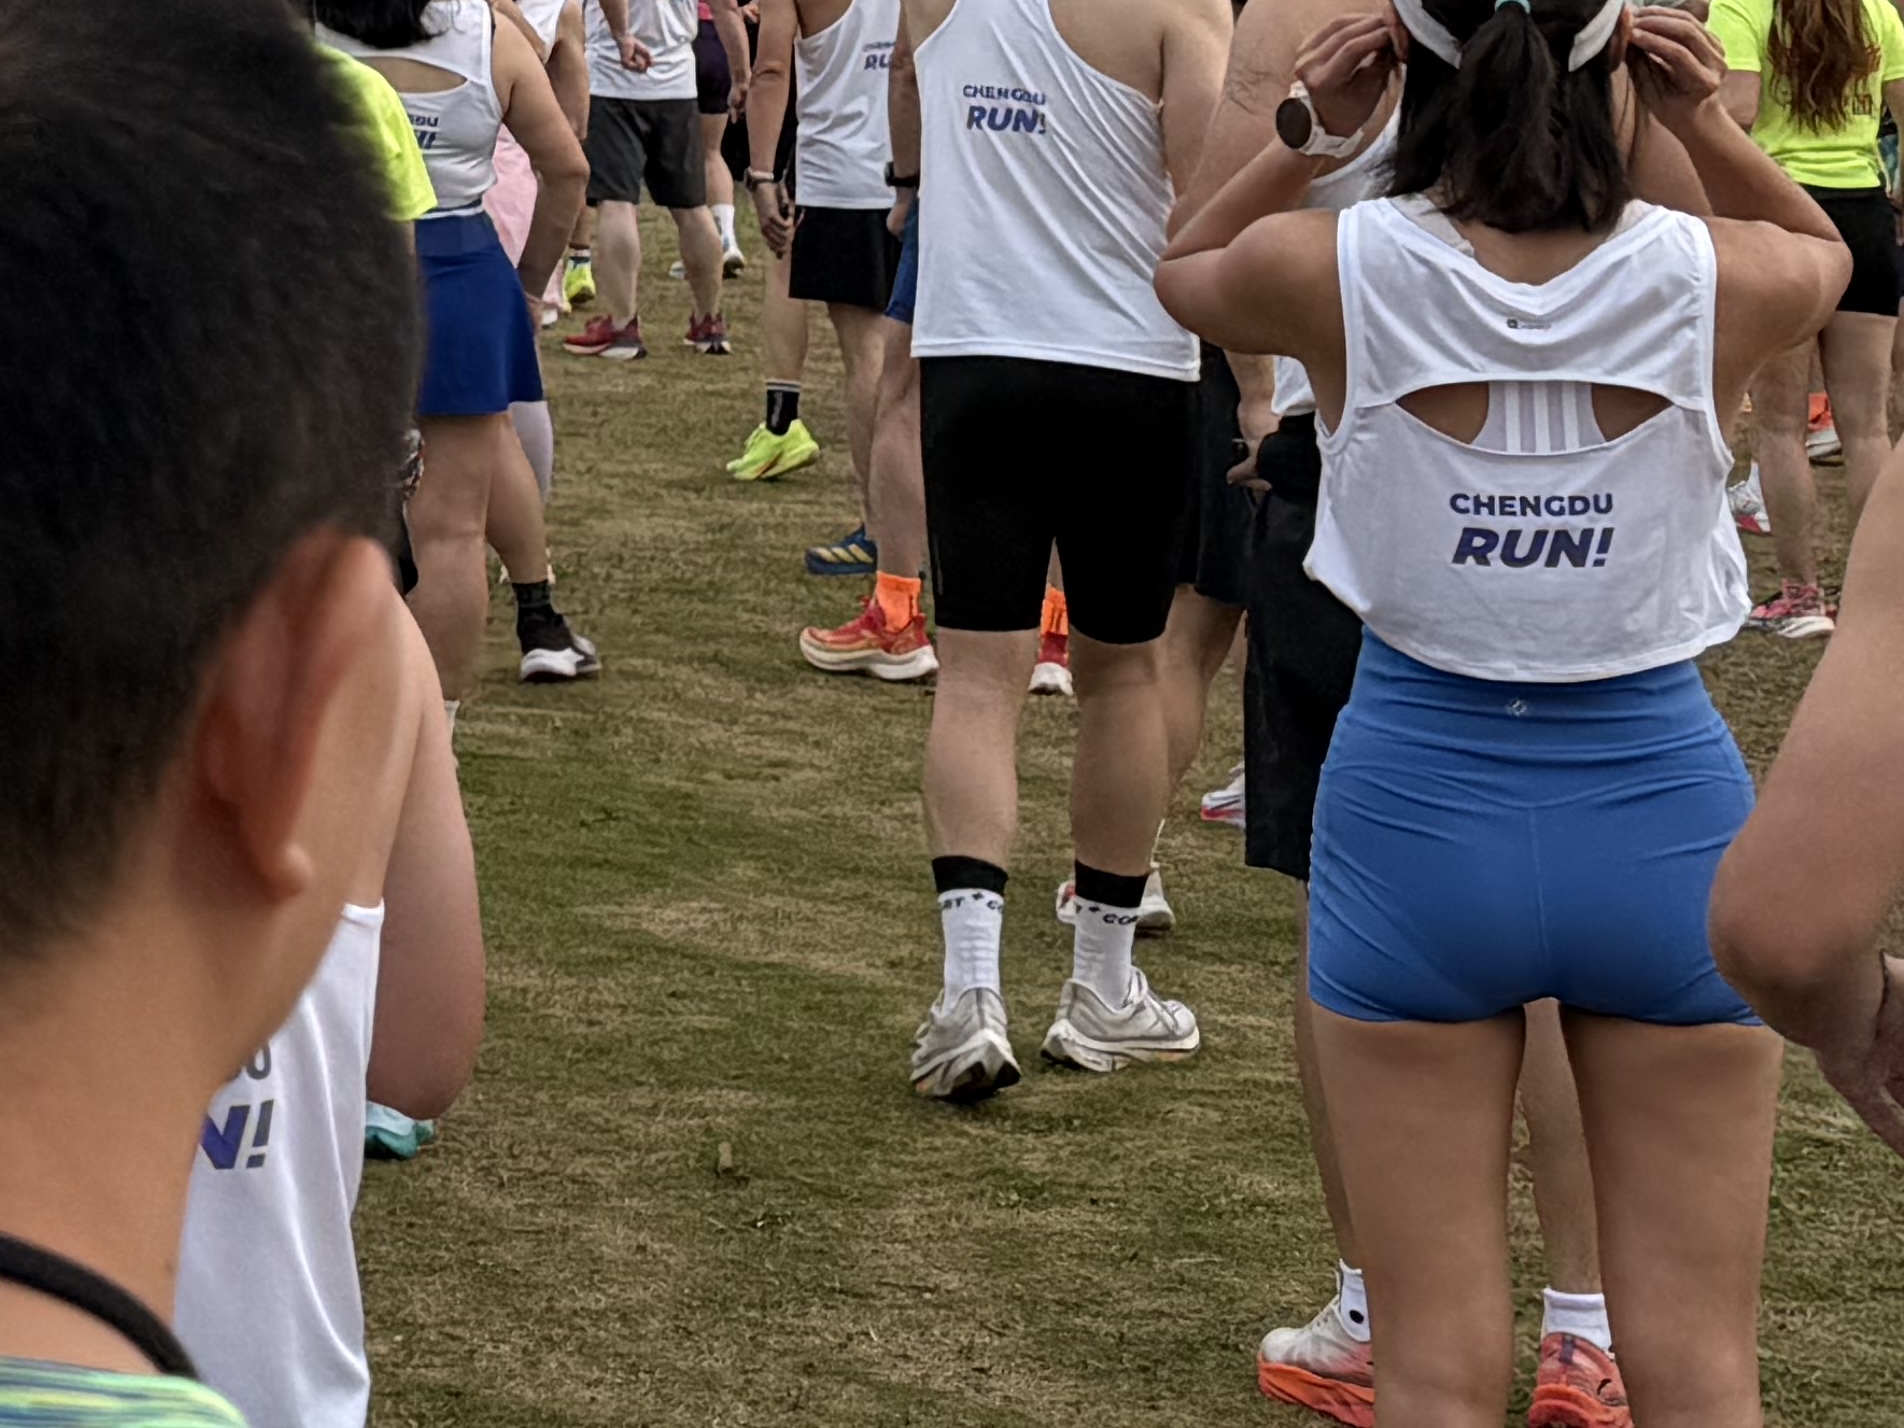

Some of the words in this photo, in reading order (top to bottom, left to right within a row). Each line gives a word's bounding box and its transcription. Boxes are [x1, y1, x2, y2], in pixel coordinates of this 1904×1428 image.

[963, 84, 1046, 106] CHENGDU
[967, 105, 1046, 134] RUN!
[1449, 493, 1614, 518] CHENGDU
[1452, 527, 1615, 568] RUN!
[200, 1098, 275, 1170] N!
